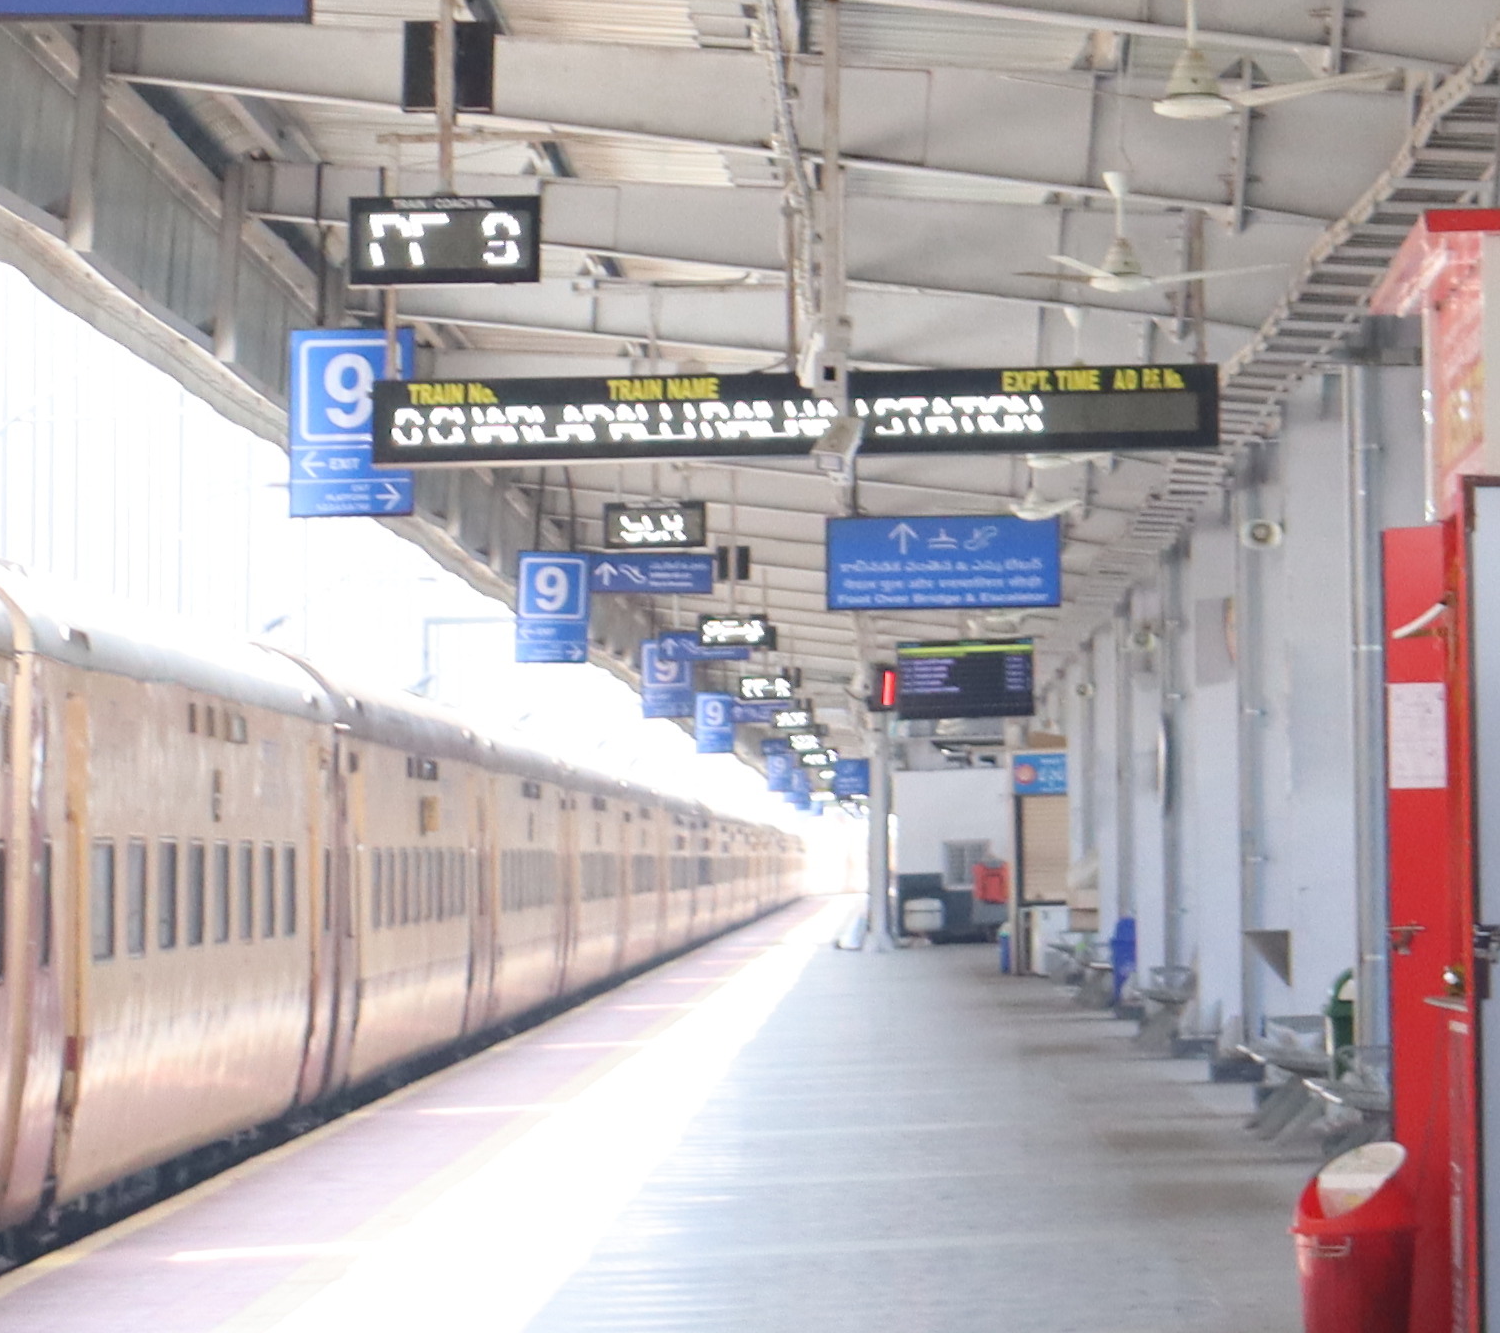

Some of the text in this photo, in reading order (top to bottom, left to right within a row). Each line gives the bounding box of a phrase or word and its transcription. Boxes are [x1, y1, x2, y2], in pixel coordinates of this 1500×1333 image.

[324, 353, 374, 429] 9
[607, 377, 720, 401] TRAIN NAME
[1053, 369, 1100, 391] TIME
[408, 383, 498, 405] TRAIN No.
[534, 566, 568, 612] 9
[706, 701, 725, 726] 9
